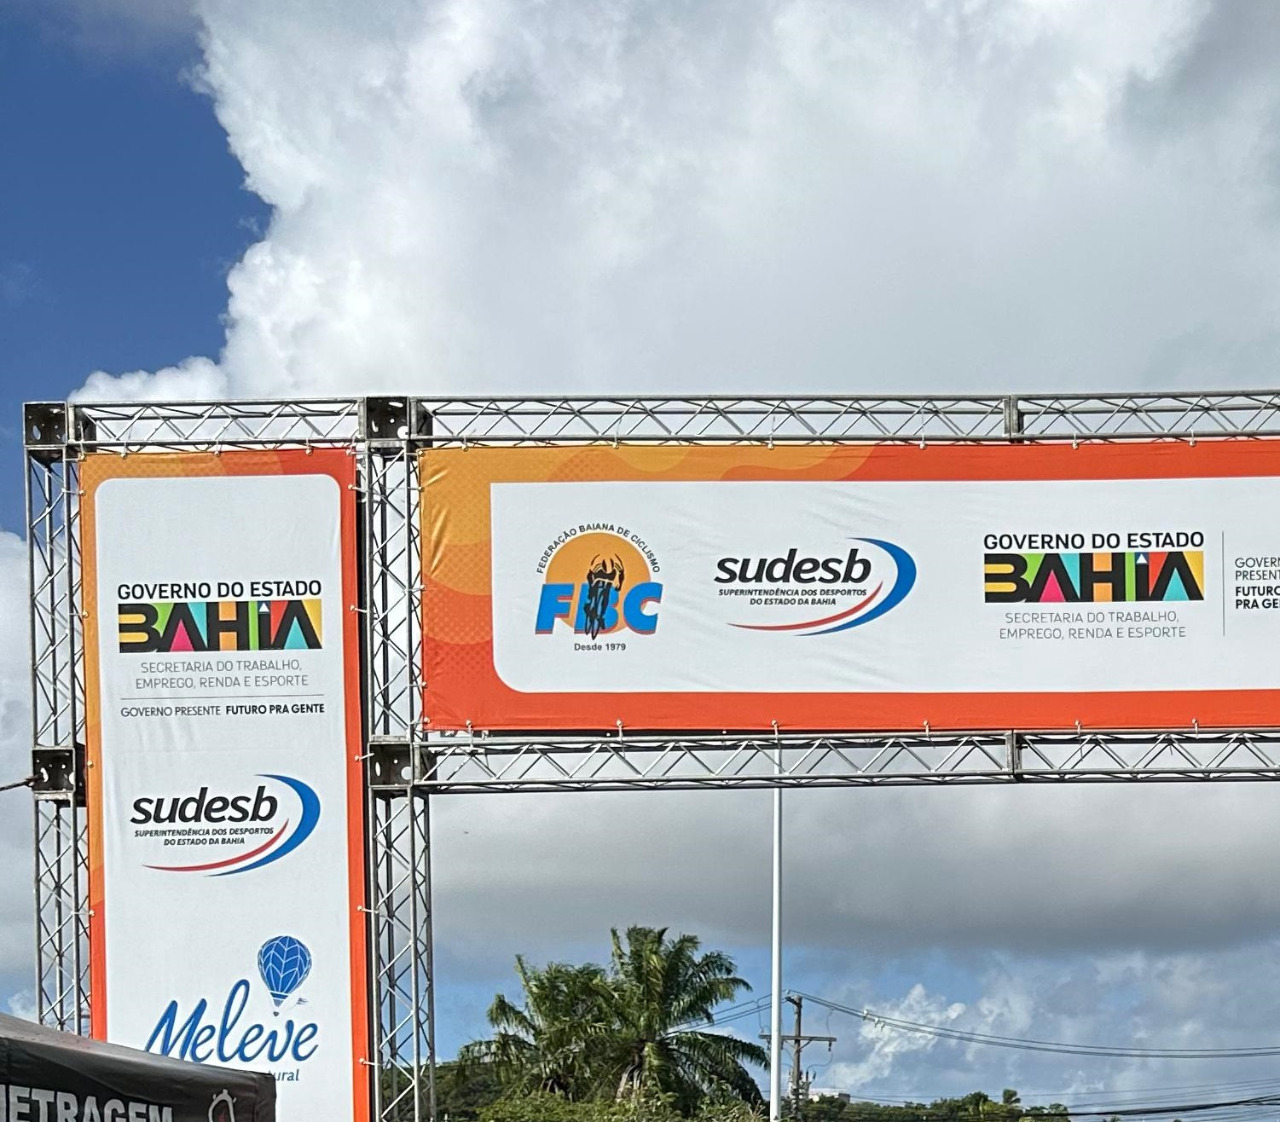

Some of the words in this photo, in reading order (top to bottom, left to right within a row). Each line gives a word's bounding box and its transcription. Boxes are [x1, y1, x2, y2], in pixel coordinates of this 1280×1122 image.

[984, 533, 1085, 550] GOVERNO
[1092, 532, 1121, 548] DO
[1127, 531, 1204, 548] ESTADO
[536, 529, 577, 574] FEDERAÇÃO
[579, 523, 615, 533] BAIANA
[616, 526, 630, 538] DE
[631, 534, 661, 573] CICLISMO
[714, 548, 872, 584] sudesb
[984, 551, 1204, 603] BAHIA
[118, 583, 211, 600] GOVERNO
[217, 582, 244, 597] DO
[251, 580, 322, 597] ESTADO
[718, 588, 799, 596] SUPERINTENDÊNCIA
[801, 588, 818, 596] DOS
[819, 588, 867, 596] DESPORTOS
[535, 582, 663, 635] FBC
[1235, 598, 1260, 609] PRA
[1005, 612, 1084, 624] SECRETARIA
[1086, 612, 1105, 623] DO
[1108, 611, 1180, 623] TRABALHO,
[118, 599, 322, 653] BAHIA
[999, 628, 1064, 640] EMPREGO,
[1069, 628, 1113, 639] RENDA
[1116, 627, 1124, 638] E
[1128, 627, 1186, 638] ESPORTE
[574, 643, 602, 651] Desde
[605, 643, 626, 651] 1979
[141, 661, 214, 673] SECRETARIA
[216, 660, 233, 671] DO
[237, 659, 302, 671] TRABALHO,
[135, 677, 196, 689] EMPREGO,
[199, 676, 241, 688] RENDA
[244, 676, 251, 686] E
[255, 675, 309, 686] ESPORTE
[120, 706, 173, 718] GOVERNO
[175, 705, 221, 716] PRESENTE
[225, 704, 267, 715] FUTURO
[269, 704, 289, 714] PRA
[291, 703, 325, 714] GENTE
[130, 785, 278, 824] sudesb
[134, 827, 210, 838] SUPERINTENDÊNCIA
[211, 828, 228, 836] DOS
[229, 827, 274, 836] DESPORTOS
[163, 838, 176, 846] DO
[176, 838, 208, 846] ESTADO
[221, 837, 245, 845] BAHIA
[145, 979, 319, 1063] Meleve
